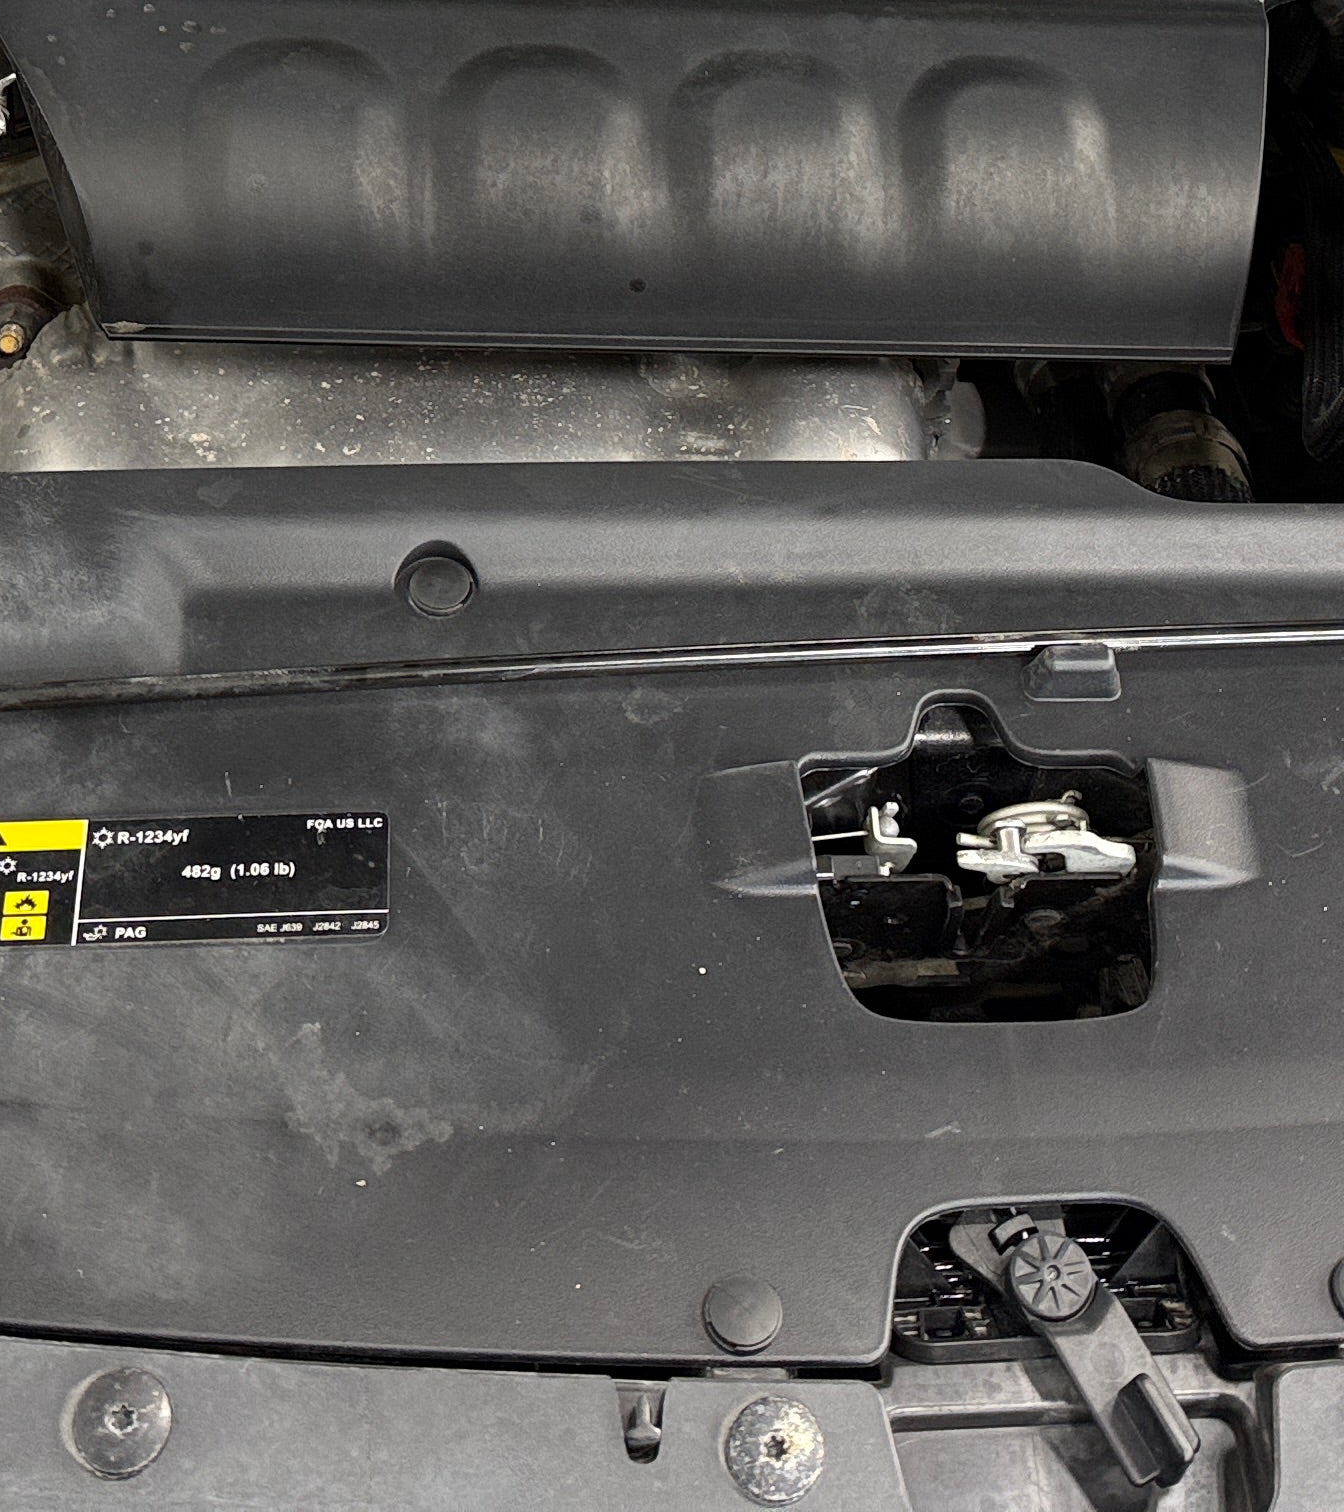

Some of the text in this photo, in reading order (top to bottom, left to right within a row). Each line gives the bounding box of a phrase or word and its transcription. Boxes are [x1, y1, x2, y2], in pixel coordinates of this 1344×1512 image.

[337, 819, 354, 829] US
[358, 817, 384, 829] LLC
[117, 829, 190, 846] R-1234yf
[16, 870, 75, 884] R-1234yf
[181, 861, 296, 880] 482g (1.06 lb)
[114, 926, 147, 939] PAG
[257, 923, 278, 933] SAE
